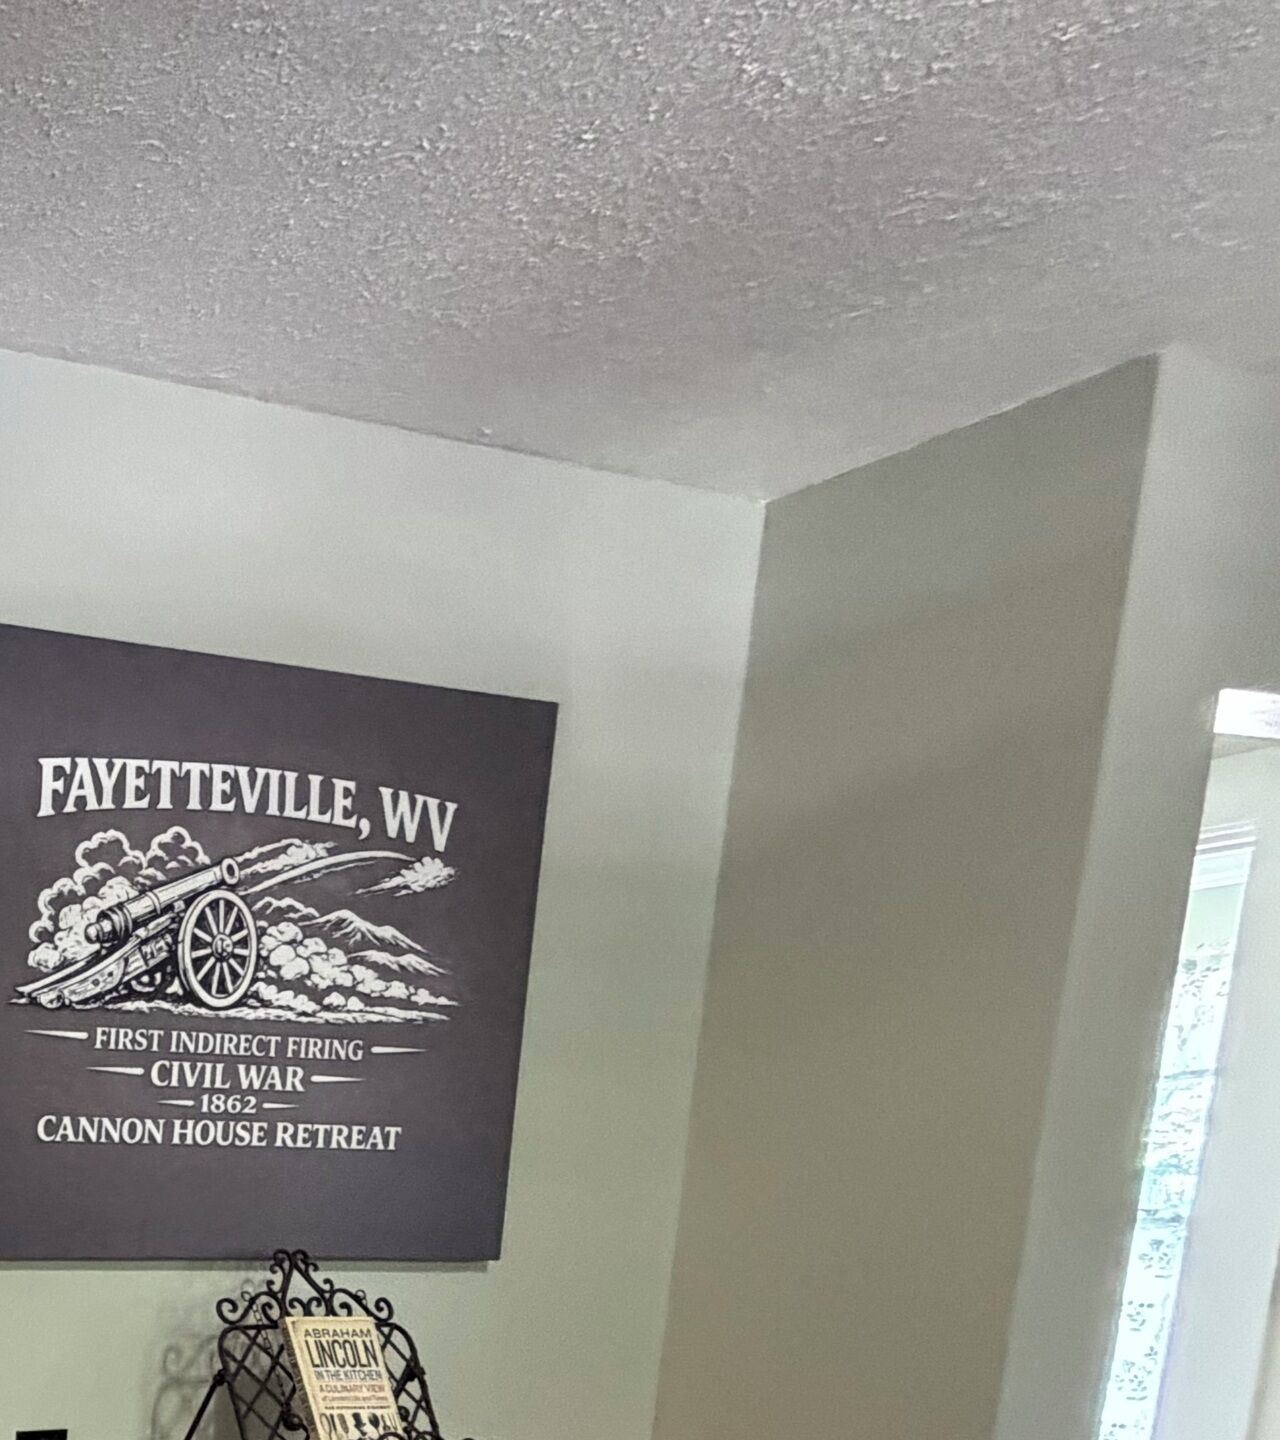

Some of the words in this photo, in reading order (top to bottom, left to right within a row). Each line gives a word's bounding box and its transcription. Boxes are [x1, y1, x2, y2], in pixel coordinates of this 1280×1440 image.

[37, 757, 371, 840] FAYETTEVILLE,
[378, 786, 458, 852] WV
[94, 1026, 164, 1052] FIRST
[169, 1030, 282, 1058] INDIRECT
[286, 1036, 364, 1061] FIRING
[150, 1059, 231, 1089] CIVIL
[238, 1063, 305, 1092] WAR
[201, 1093, 257, 1114] 1862
[37, 1114, 166, 1144] CANNON
[172, 1119, 268, 1147] HOUSE
[274, 1122, 402, 1150] RETREAT
[303, 1327, 372, 1339] ABRAHAM
[304, 1339, 380, 1369] LINCOLN
[314, 1369, 325, 1381] IN
[325, 1369, 343, 1381] THE
[343, 1369, 383, 1381] KITCHEN
